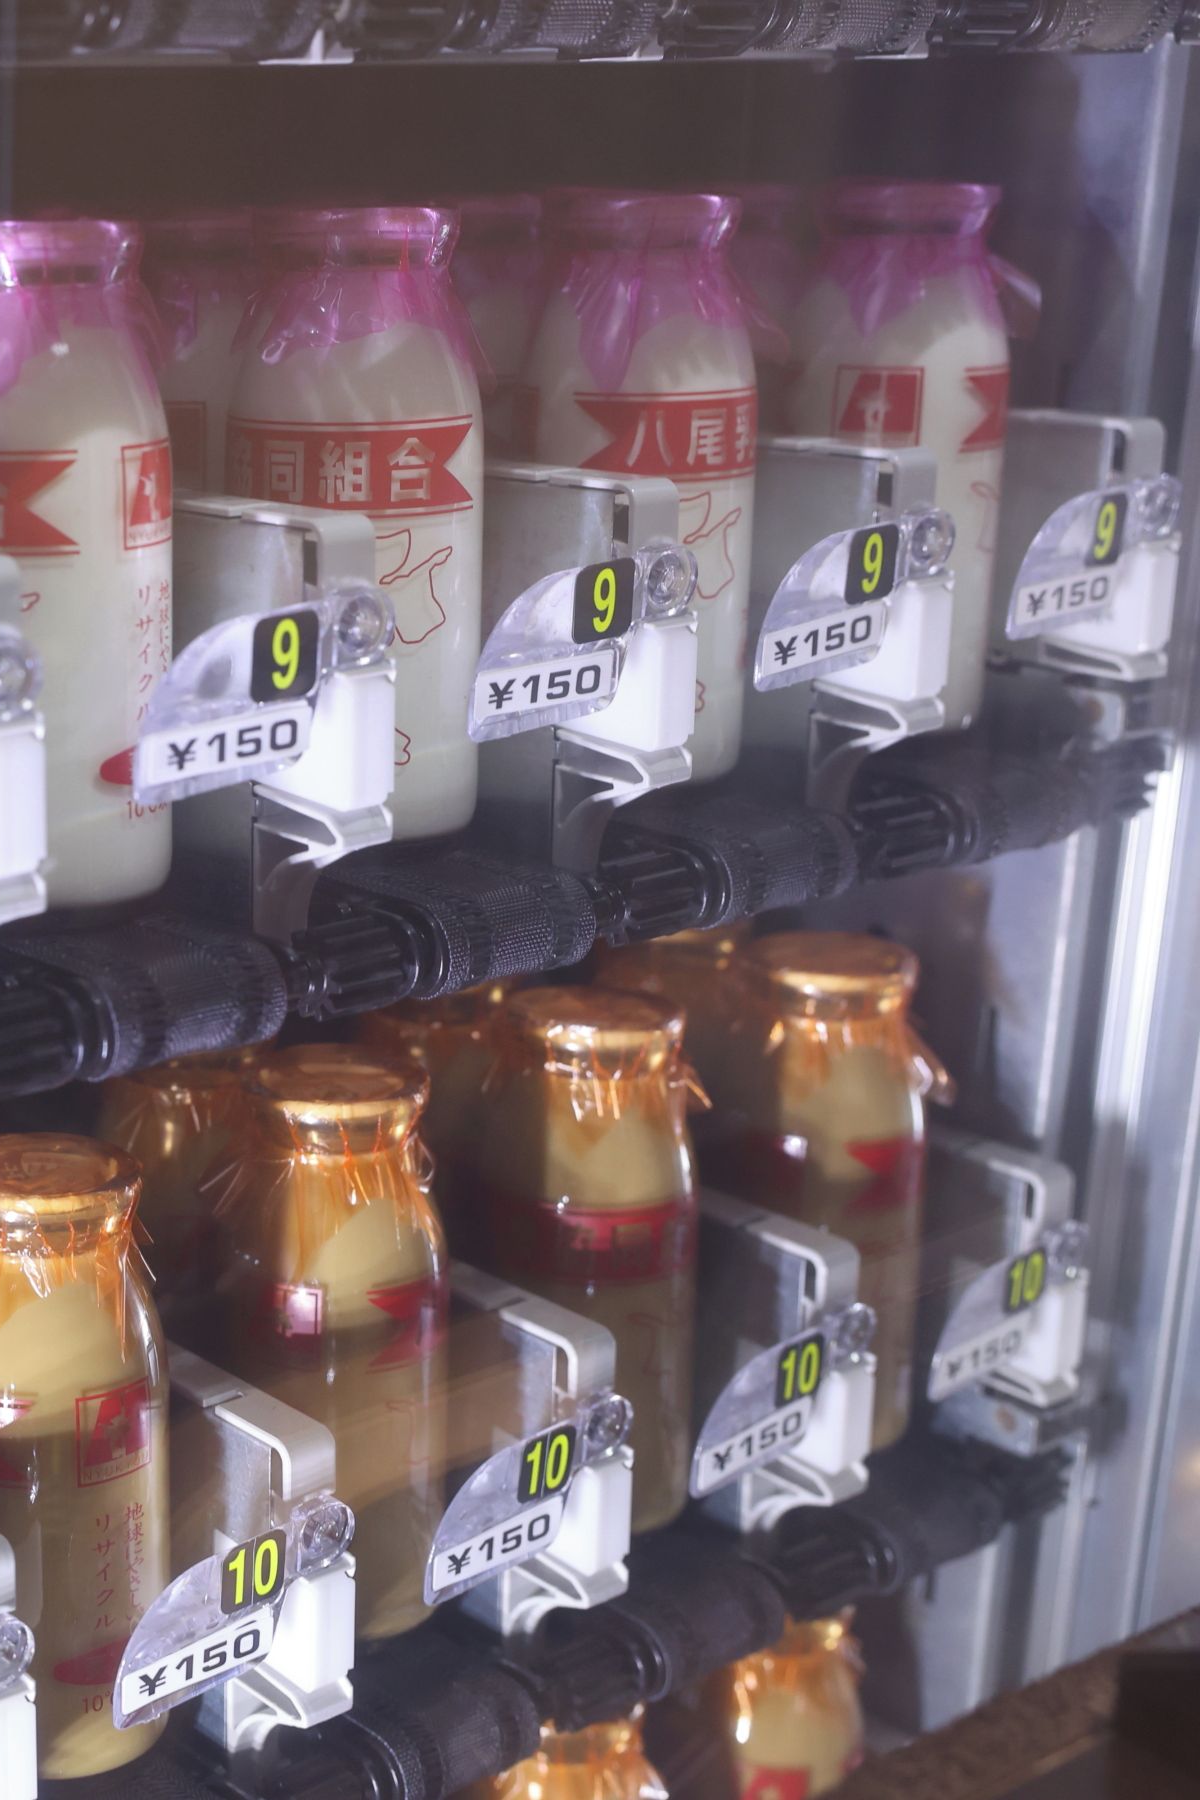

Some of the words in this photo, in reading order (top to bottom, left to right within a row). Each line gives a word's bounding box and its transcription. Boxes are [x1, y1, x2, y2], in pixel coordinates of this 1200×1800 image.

[1094, 501, 1117, 560] 9
[862, 533, 884, 594] 9
[593, 567, 616, 633] 9
[1026, 576, 1109, 617] ¥150
[272, 618, 299, 690] 9
[774, 615, 872, 666] ¥150
[488, 665, 601, 710] ¥150
[167, 719, 299, 771] ¥150
[1009, 1252, 1044, 1308] 10
[782, 1342, 820, 1401] 10
[947, 1330, 1022, 1379] ¥150
[526, 1434, 570, 1495] 10
[714, 1412, 802, 1472] ¥150
[91, 1514, 116, 1630] リサイクル
[228, 1538, 279, 1605] 10
[447, 1514, 551, 1575] ¥150
[138, 1628, 261, 1696] ¥150
